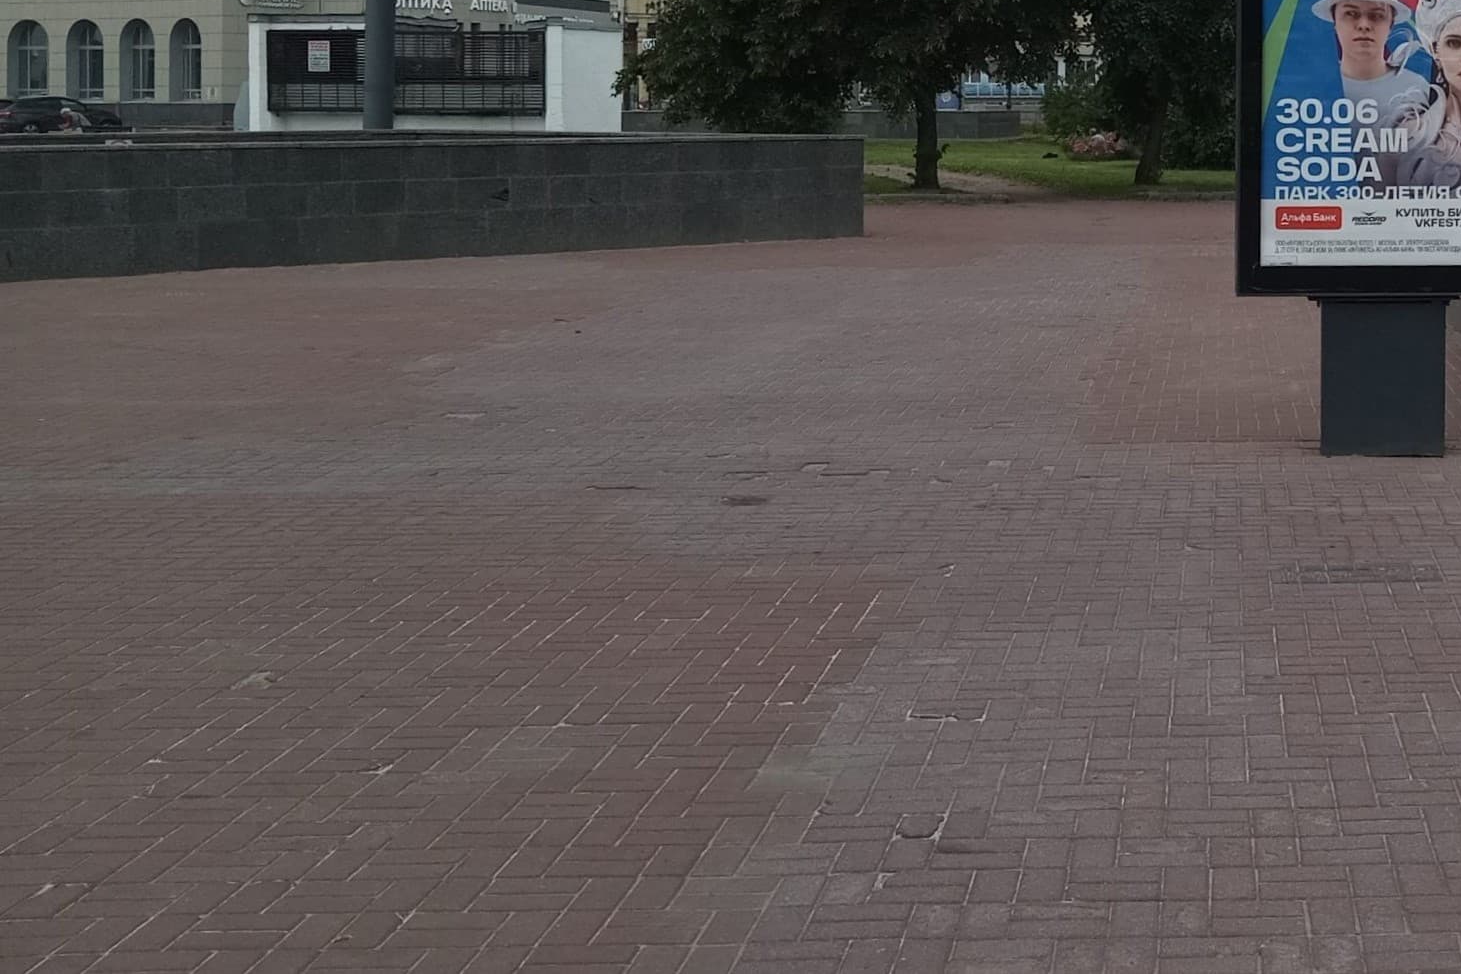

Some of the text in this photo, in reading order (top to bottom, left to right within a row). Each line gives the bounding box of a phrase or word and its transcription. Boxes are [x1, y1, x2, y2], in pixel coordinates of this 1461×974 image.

[1276, 98, 1378, 124] 30.06
[1275, 128, 1409, 153] CREAM
[1276, 157, 1383, 182] SODA
[1275, 186, 1331, 200] ПАРК
[1336, 186, 1451, 200] 300-ЛЕТИЯ
[1280, 213, 1337, 224] Альфа Банк
[1396, 208, 1445, 218] КУПИТЬ
